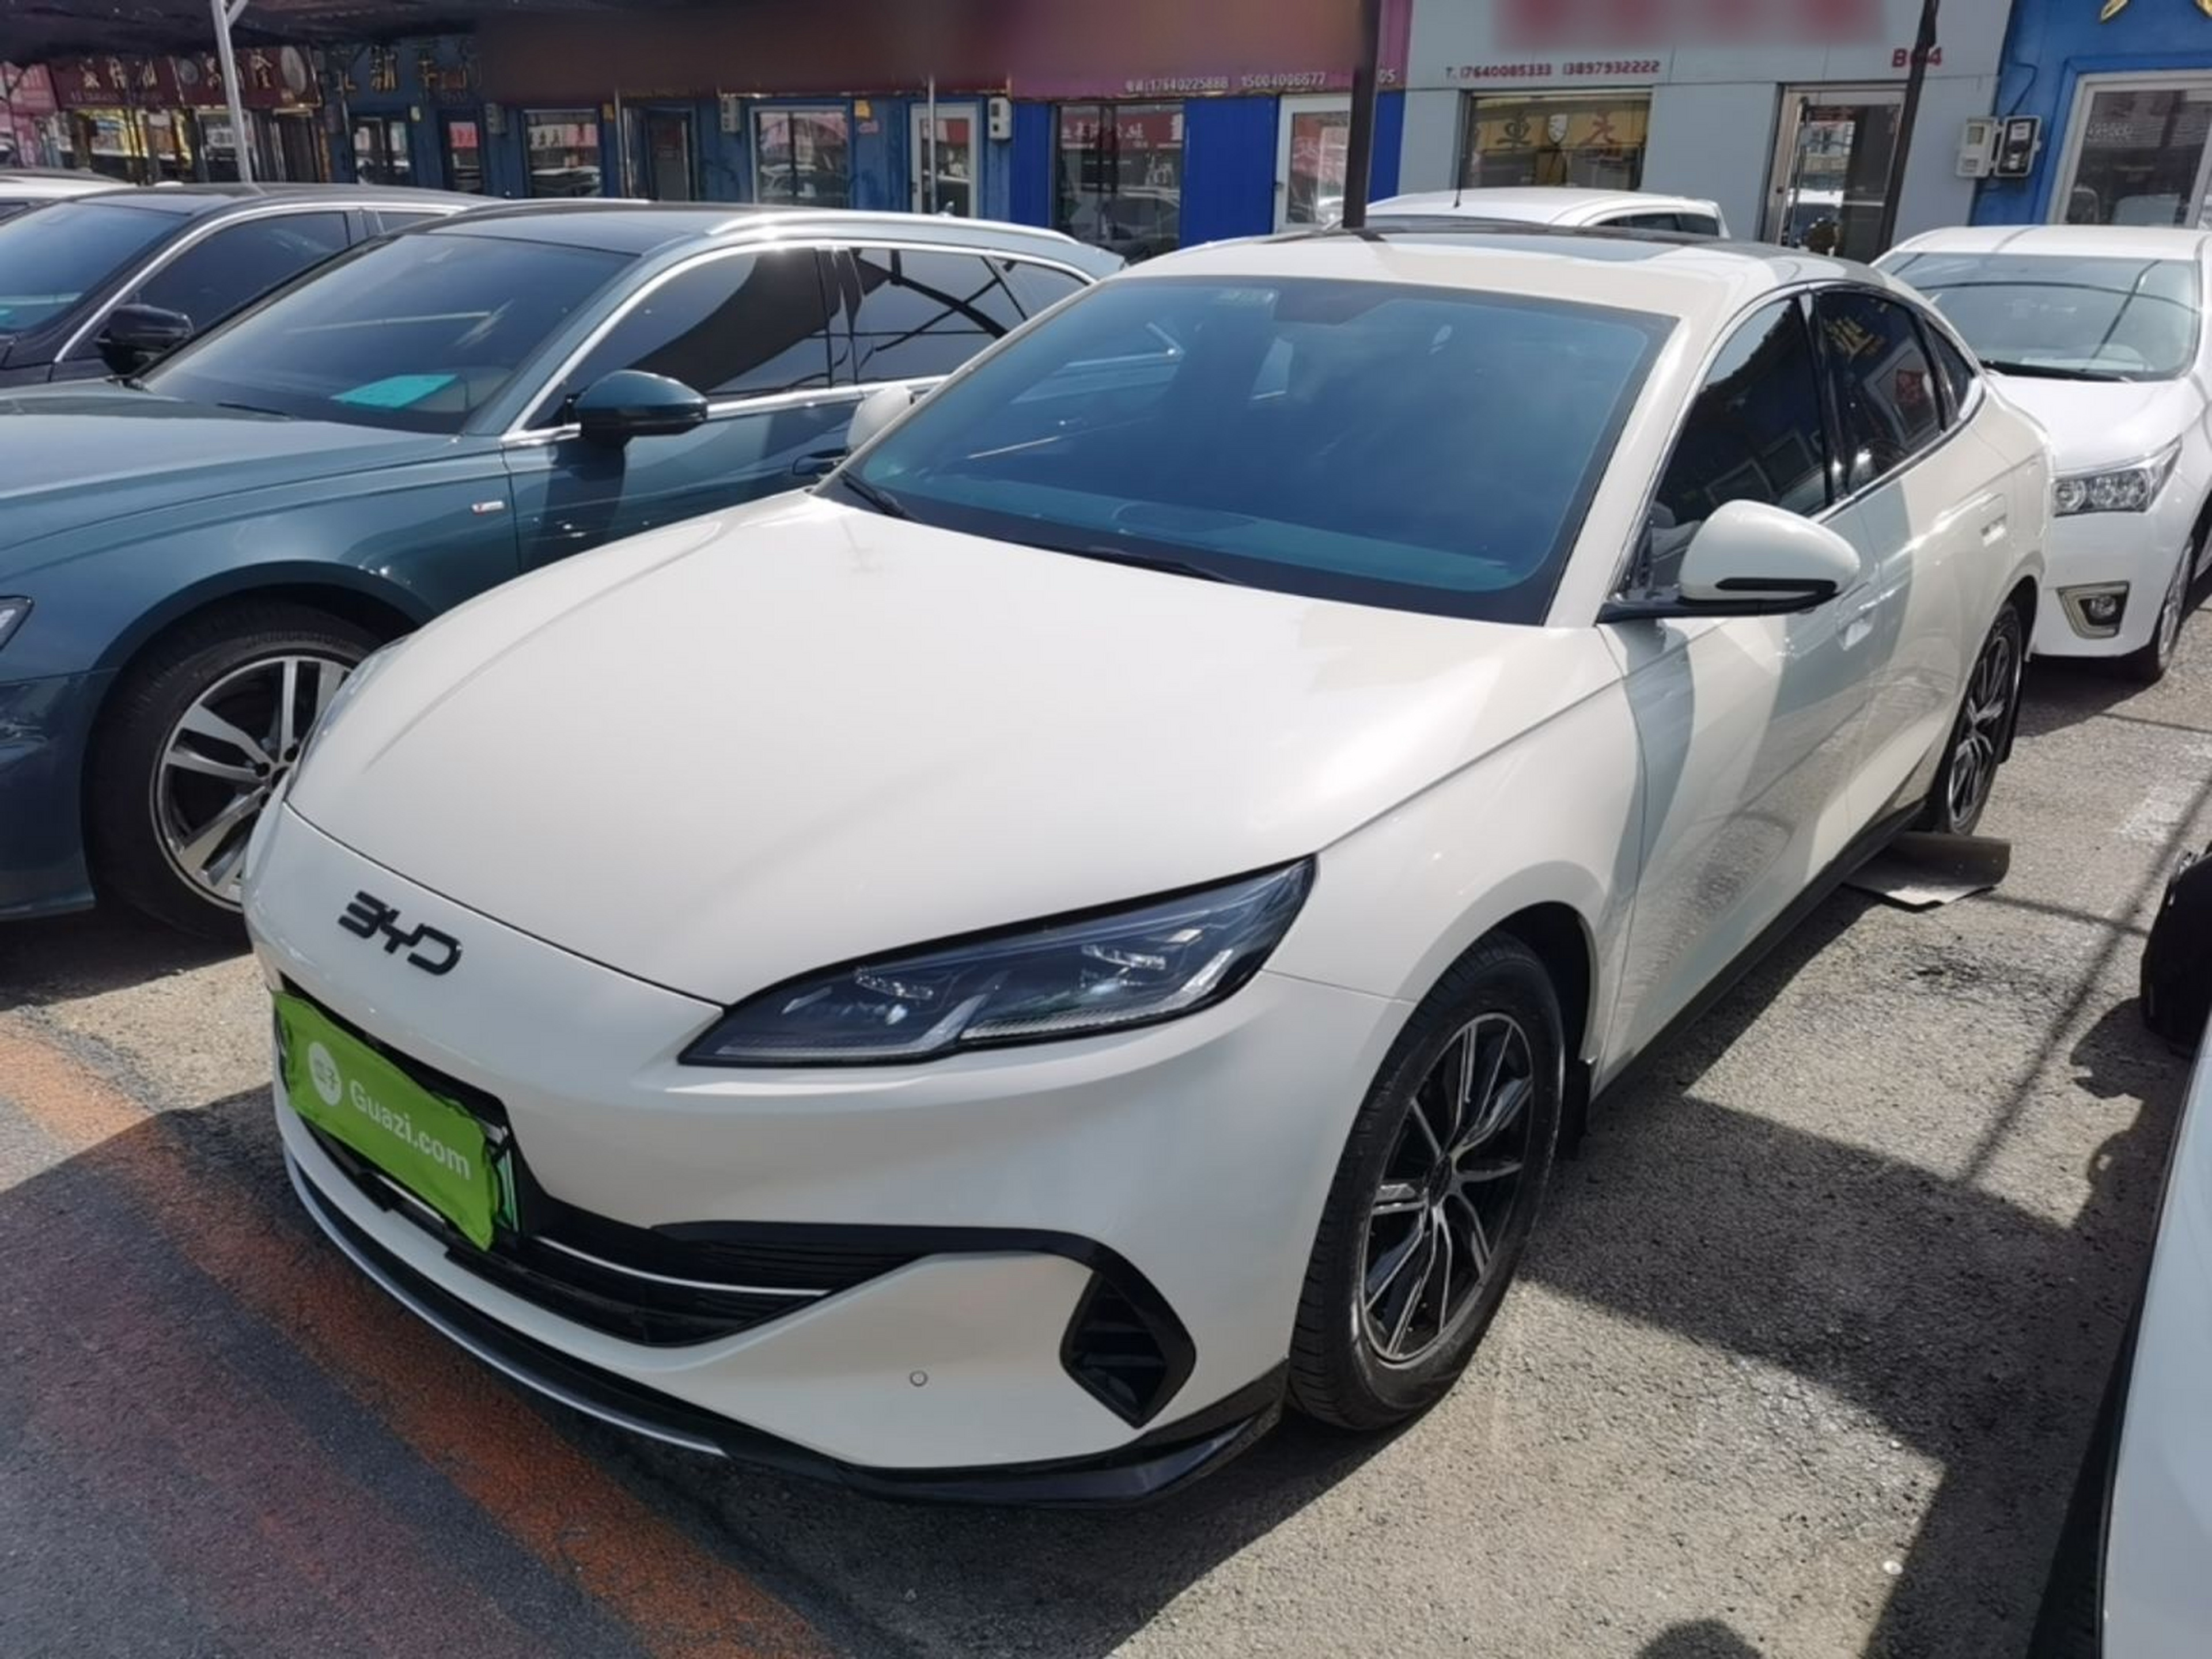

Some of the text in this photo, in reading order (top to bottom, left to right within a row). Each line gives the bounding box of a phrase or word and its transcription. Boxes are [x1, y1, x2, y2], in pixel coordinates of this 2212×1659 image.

[1892, 47, 1942, 67] B4
[338, 890, 463, 976] BYD
[349, 1078, 471, 1181] Guazi.com
